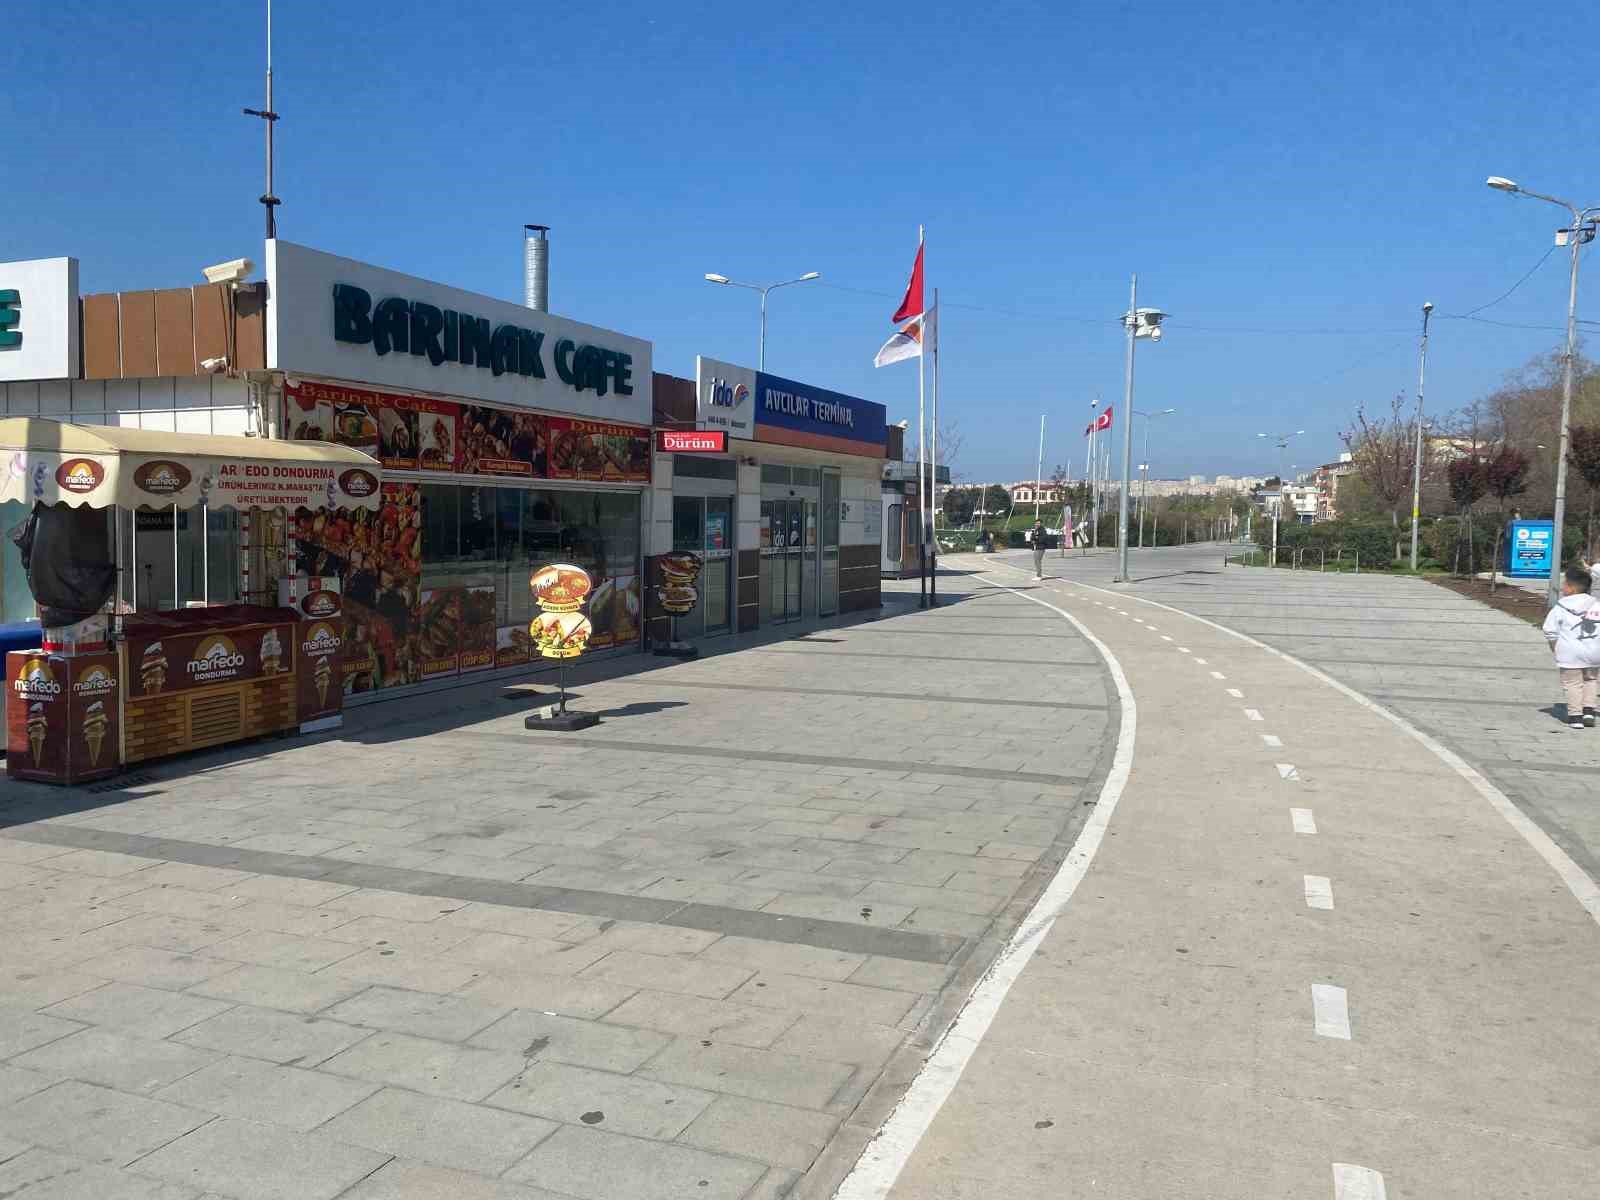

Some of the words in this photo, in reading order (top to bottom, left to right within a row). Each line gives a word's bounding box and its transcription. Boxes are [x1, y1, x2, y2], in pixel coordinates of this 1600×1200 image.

[332, 283, 546, 380] BARINAK
[553, 336, 633, 396] CAFE
[709, 377, 733, 407] ido
[765, 388, 810, 417] AVCILAR
[663, 436, 715, 449] Dürüm
[272, 466, 335, 479] DONDURMA
[186, 651, 244, 673] marfedo
[194, 669, 237, 681] DONDURMA
